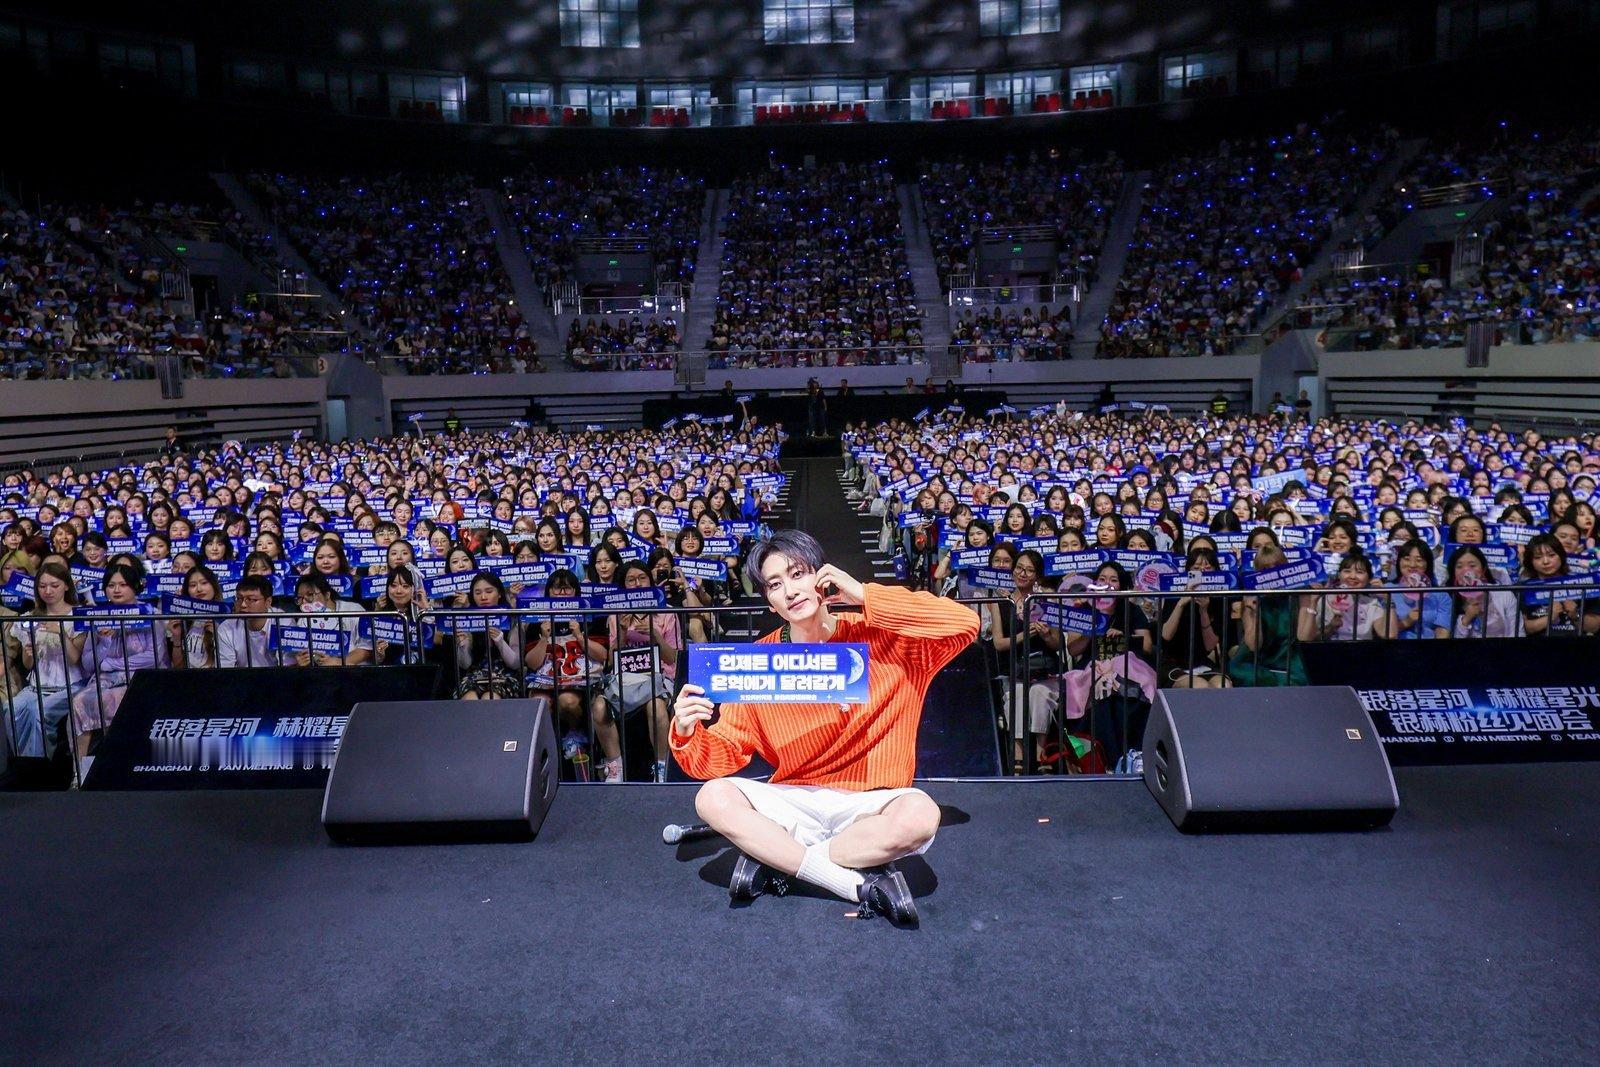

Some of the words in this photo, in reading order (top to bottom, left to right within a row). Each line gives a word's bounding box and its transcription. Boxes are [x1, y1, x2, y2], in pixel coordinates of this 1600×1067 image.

[720, 654, 768, 670] 언제든
[772, 654, 837, 671] 어디서든
[712, 674, 776, 691] 은혁에게
[1358, 689, 1475, 711] 银落星河
[149, 718, 262, 739] 银落星河
[1389, 709, 1594, 733] 银赫粉丝见面会
